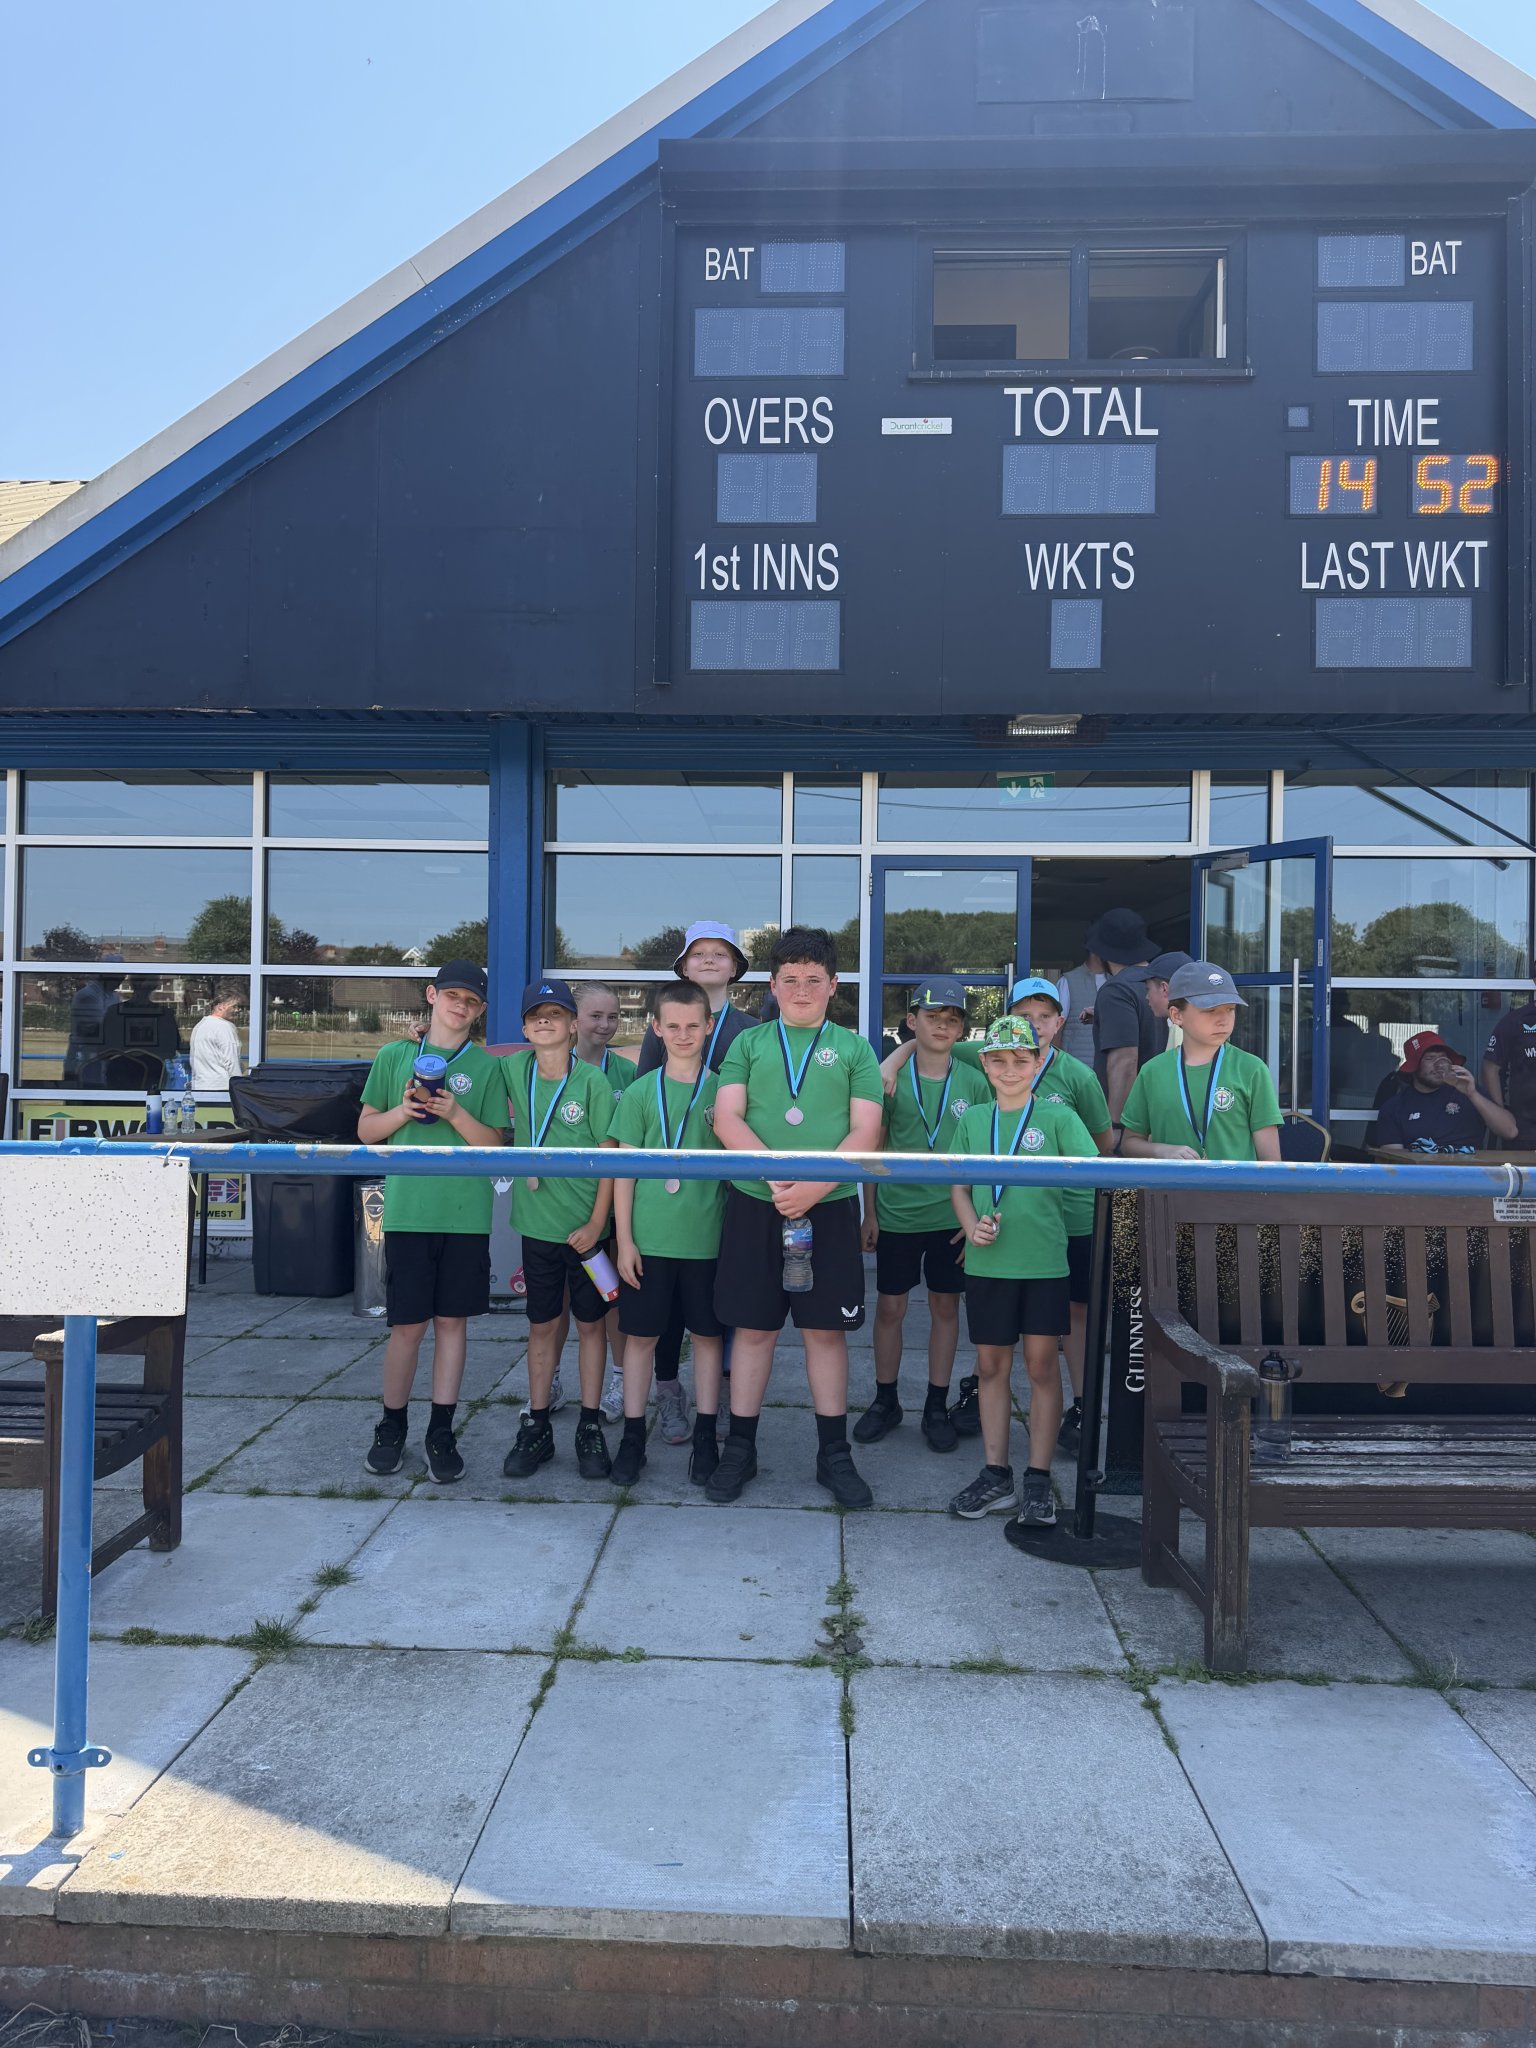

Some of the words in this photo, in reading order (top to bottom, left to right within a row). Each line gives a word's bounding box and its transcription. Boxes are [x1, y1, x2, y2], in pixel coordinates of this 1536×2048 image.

[705, 247, 755, 281] BAT
[1411, 240, 1462, 275] BAT
[704, 396, 834, 445] OVERS
[1003, 386, 1159, 437] TOTAL
[1348, 398, 1440, 446] TIME
[1318, 460, 1375, 511] 14
[1416, 455, 1499, 514] 52
[694, 543, 741, 591] 1st
[752, 542, 839, 591] INNS
[1024, 541, 1135, 591] WKTS
[1301, 542, 1393, 590] LAST
[1404, 540, 1488, 589] WKT
[207, 1210, 233, 1218] WEST
[1125, 1286, 1145, 1393] GUINNESS
